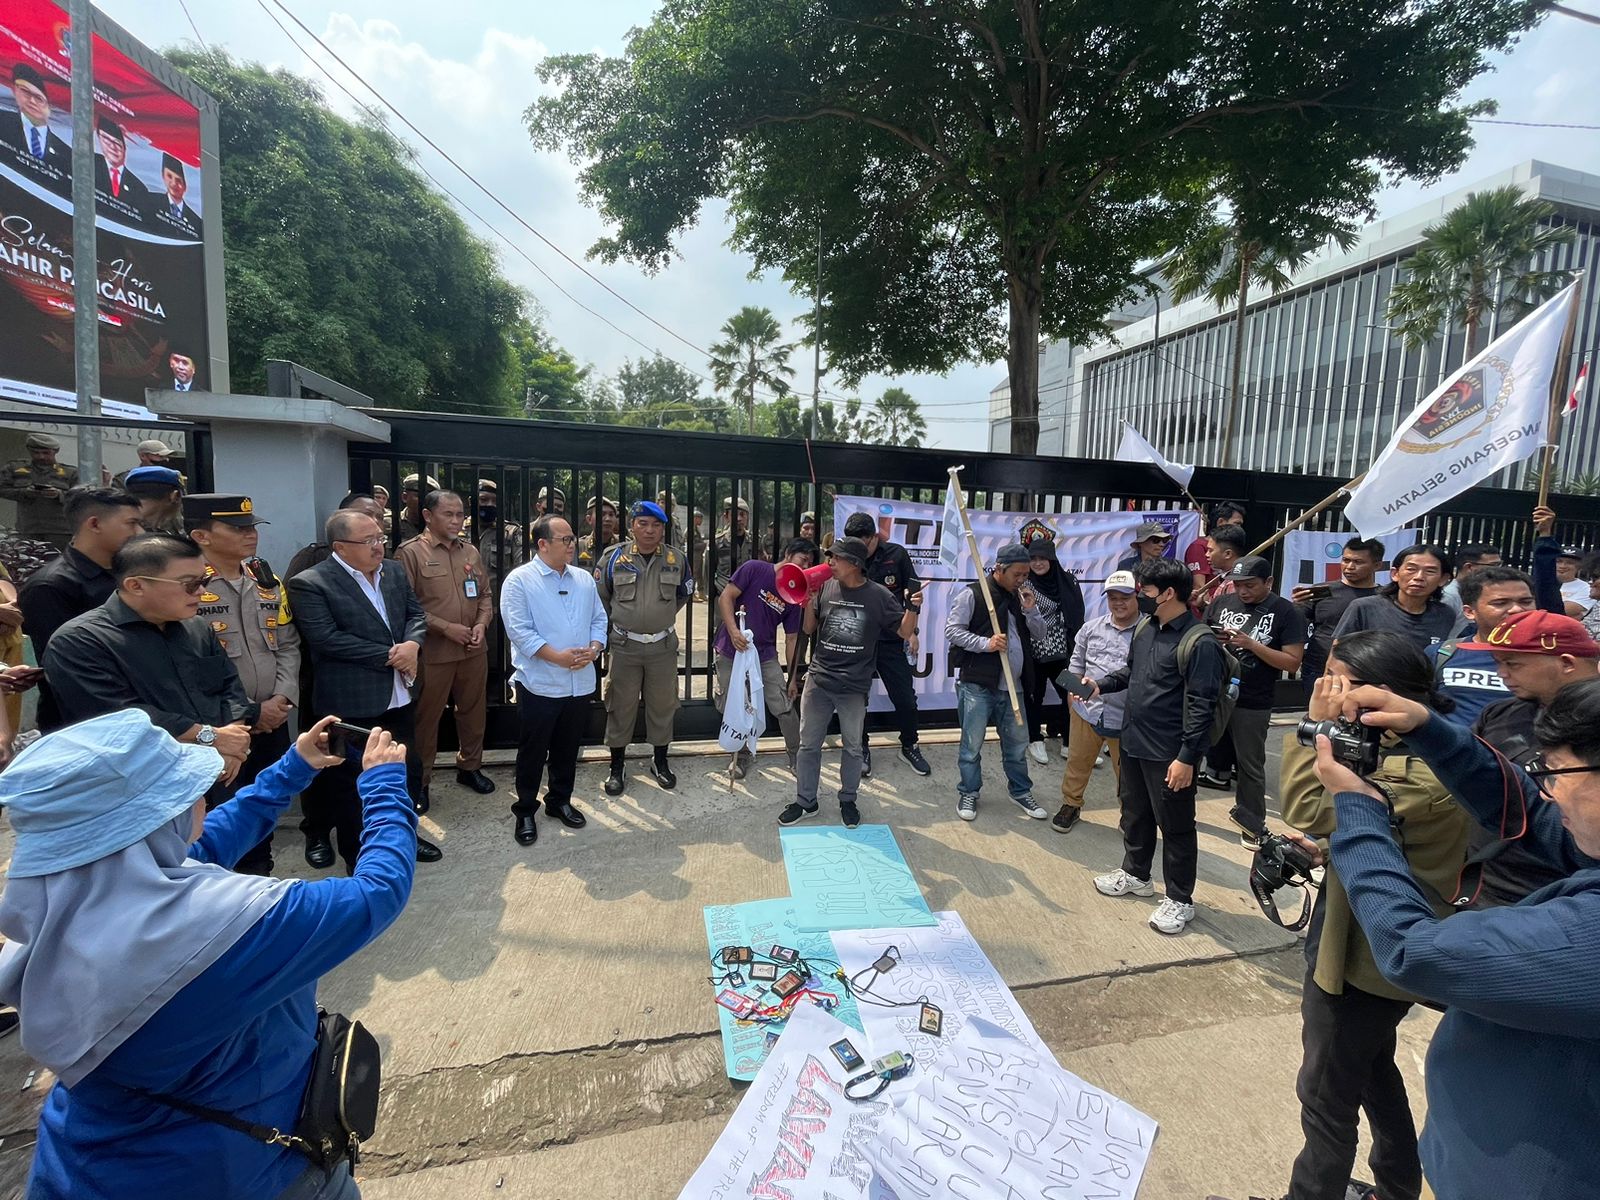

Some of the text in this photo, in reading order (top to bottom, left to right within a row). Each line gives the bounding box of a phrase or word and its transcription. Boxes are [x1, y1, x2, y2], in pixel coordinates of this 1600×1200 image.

[1, 215, 74, 262] Selam
[60, 264, 166, 318] PCASILA
[1451, 671, 1500, 687] PRE
[791, 844, 861, 888] KPI
